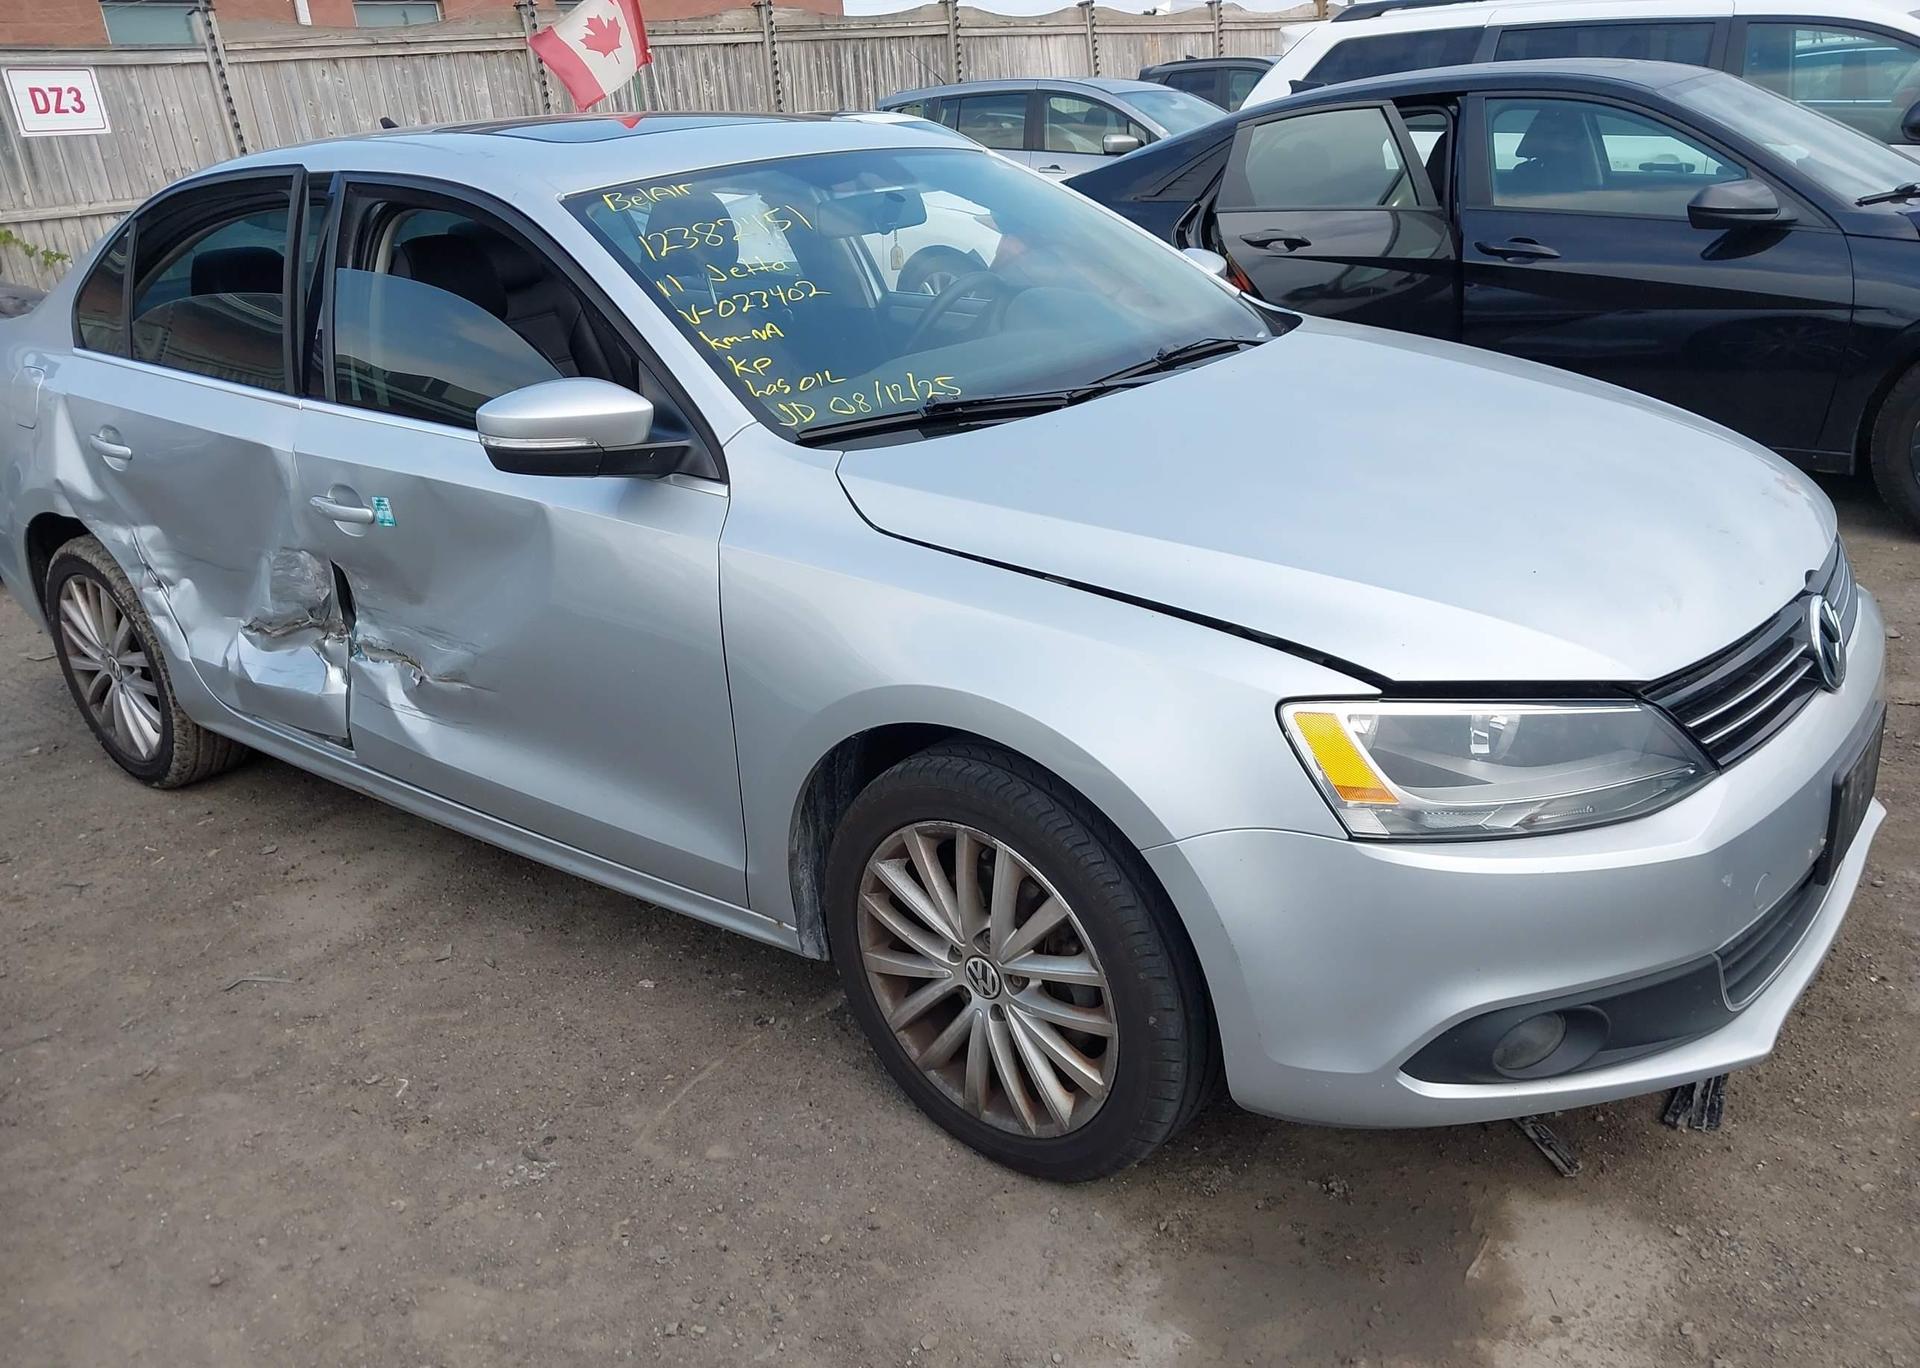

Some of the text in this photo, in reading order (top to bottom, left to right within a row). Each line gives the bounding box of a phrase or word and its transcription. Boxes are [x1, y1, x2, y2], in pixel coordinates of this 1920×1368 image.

[28, 86, 86, 114] DZ3
[705, 256, 791, 282] Jetta
[745, 378, 792, 397] has
[829, 372, 962, 415] 08/12/25
